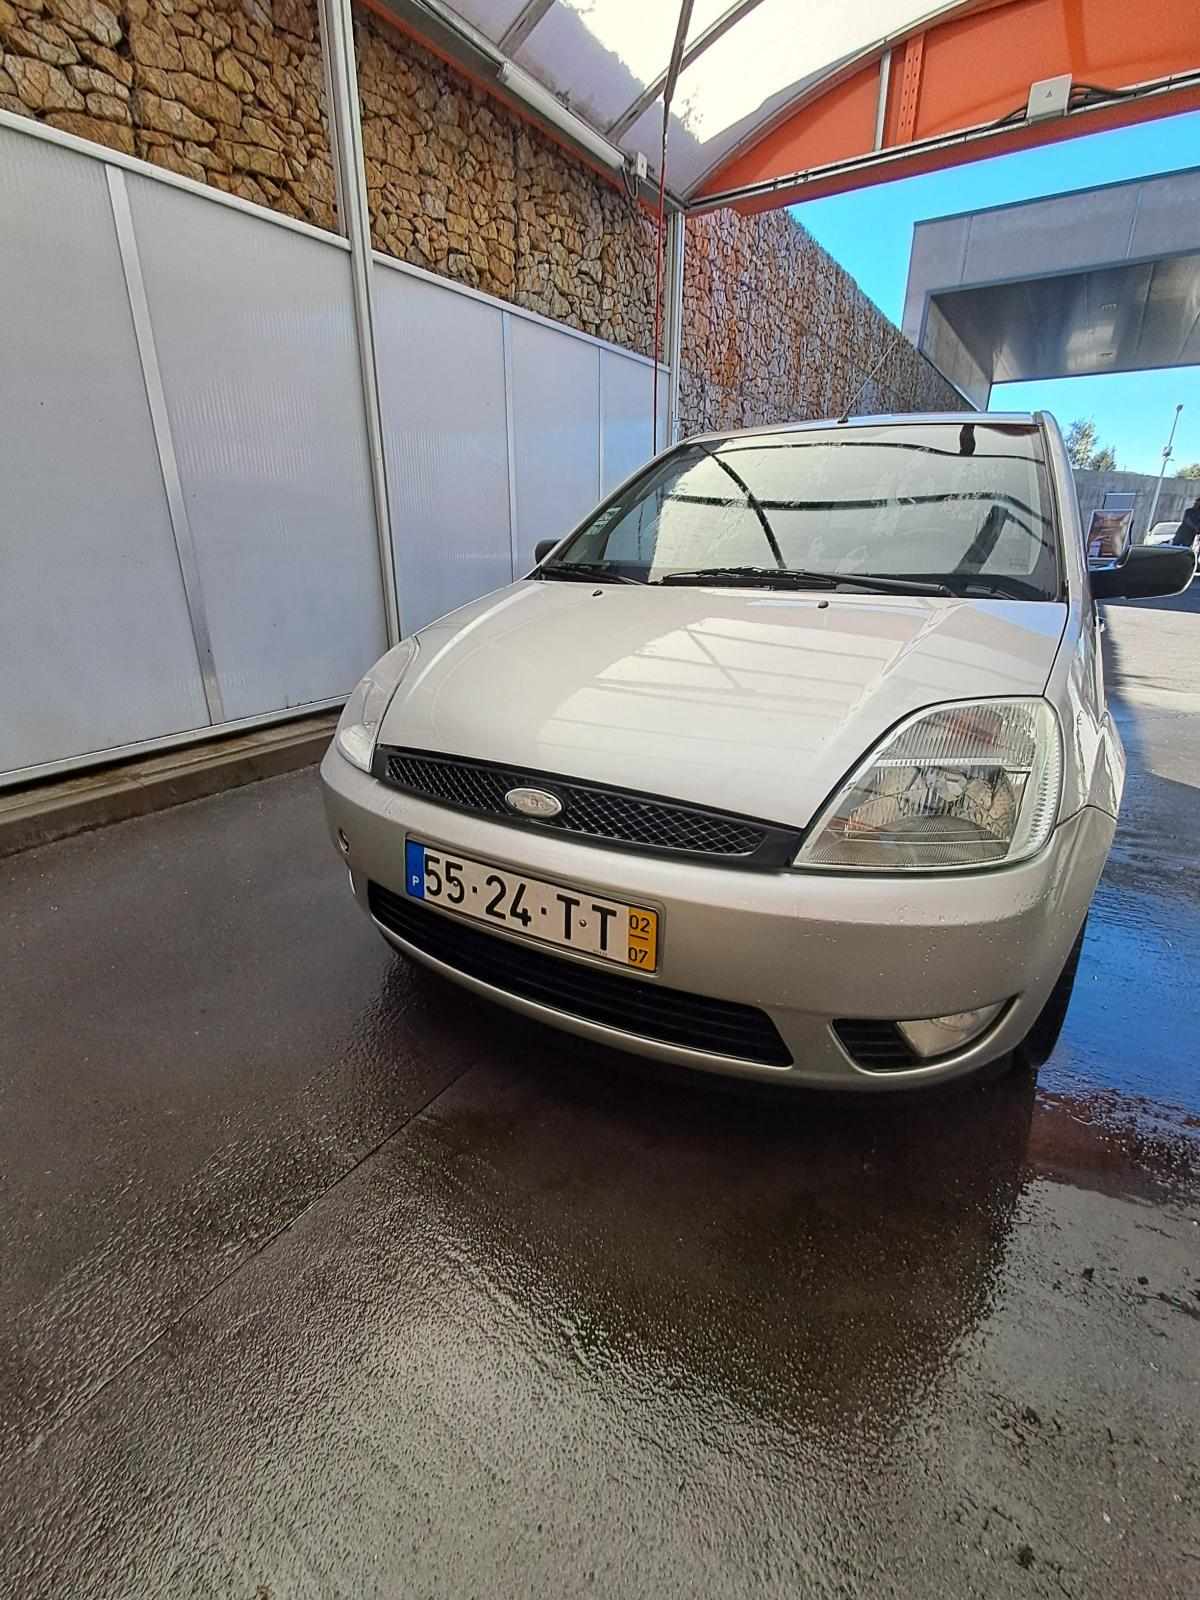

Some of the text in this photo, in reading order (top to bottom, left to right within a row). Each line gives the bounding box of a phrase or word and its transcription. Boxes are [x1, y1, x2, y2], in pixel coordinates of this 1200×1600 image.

[412, 875, 420, 887] P
[630, 915, 650, 934] 02
[628, 947, 649, 963] 07
